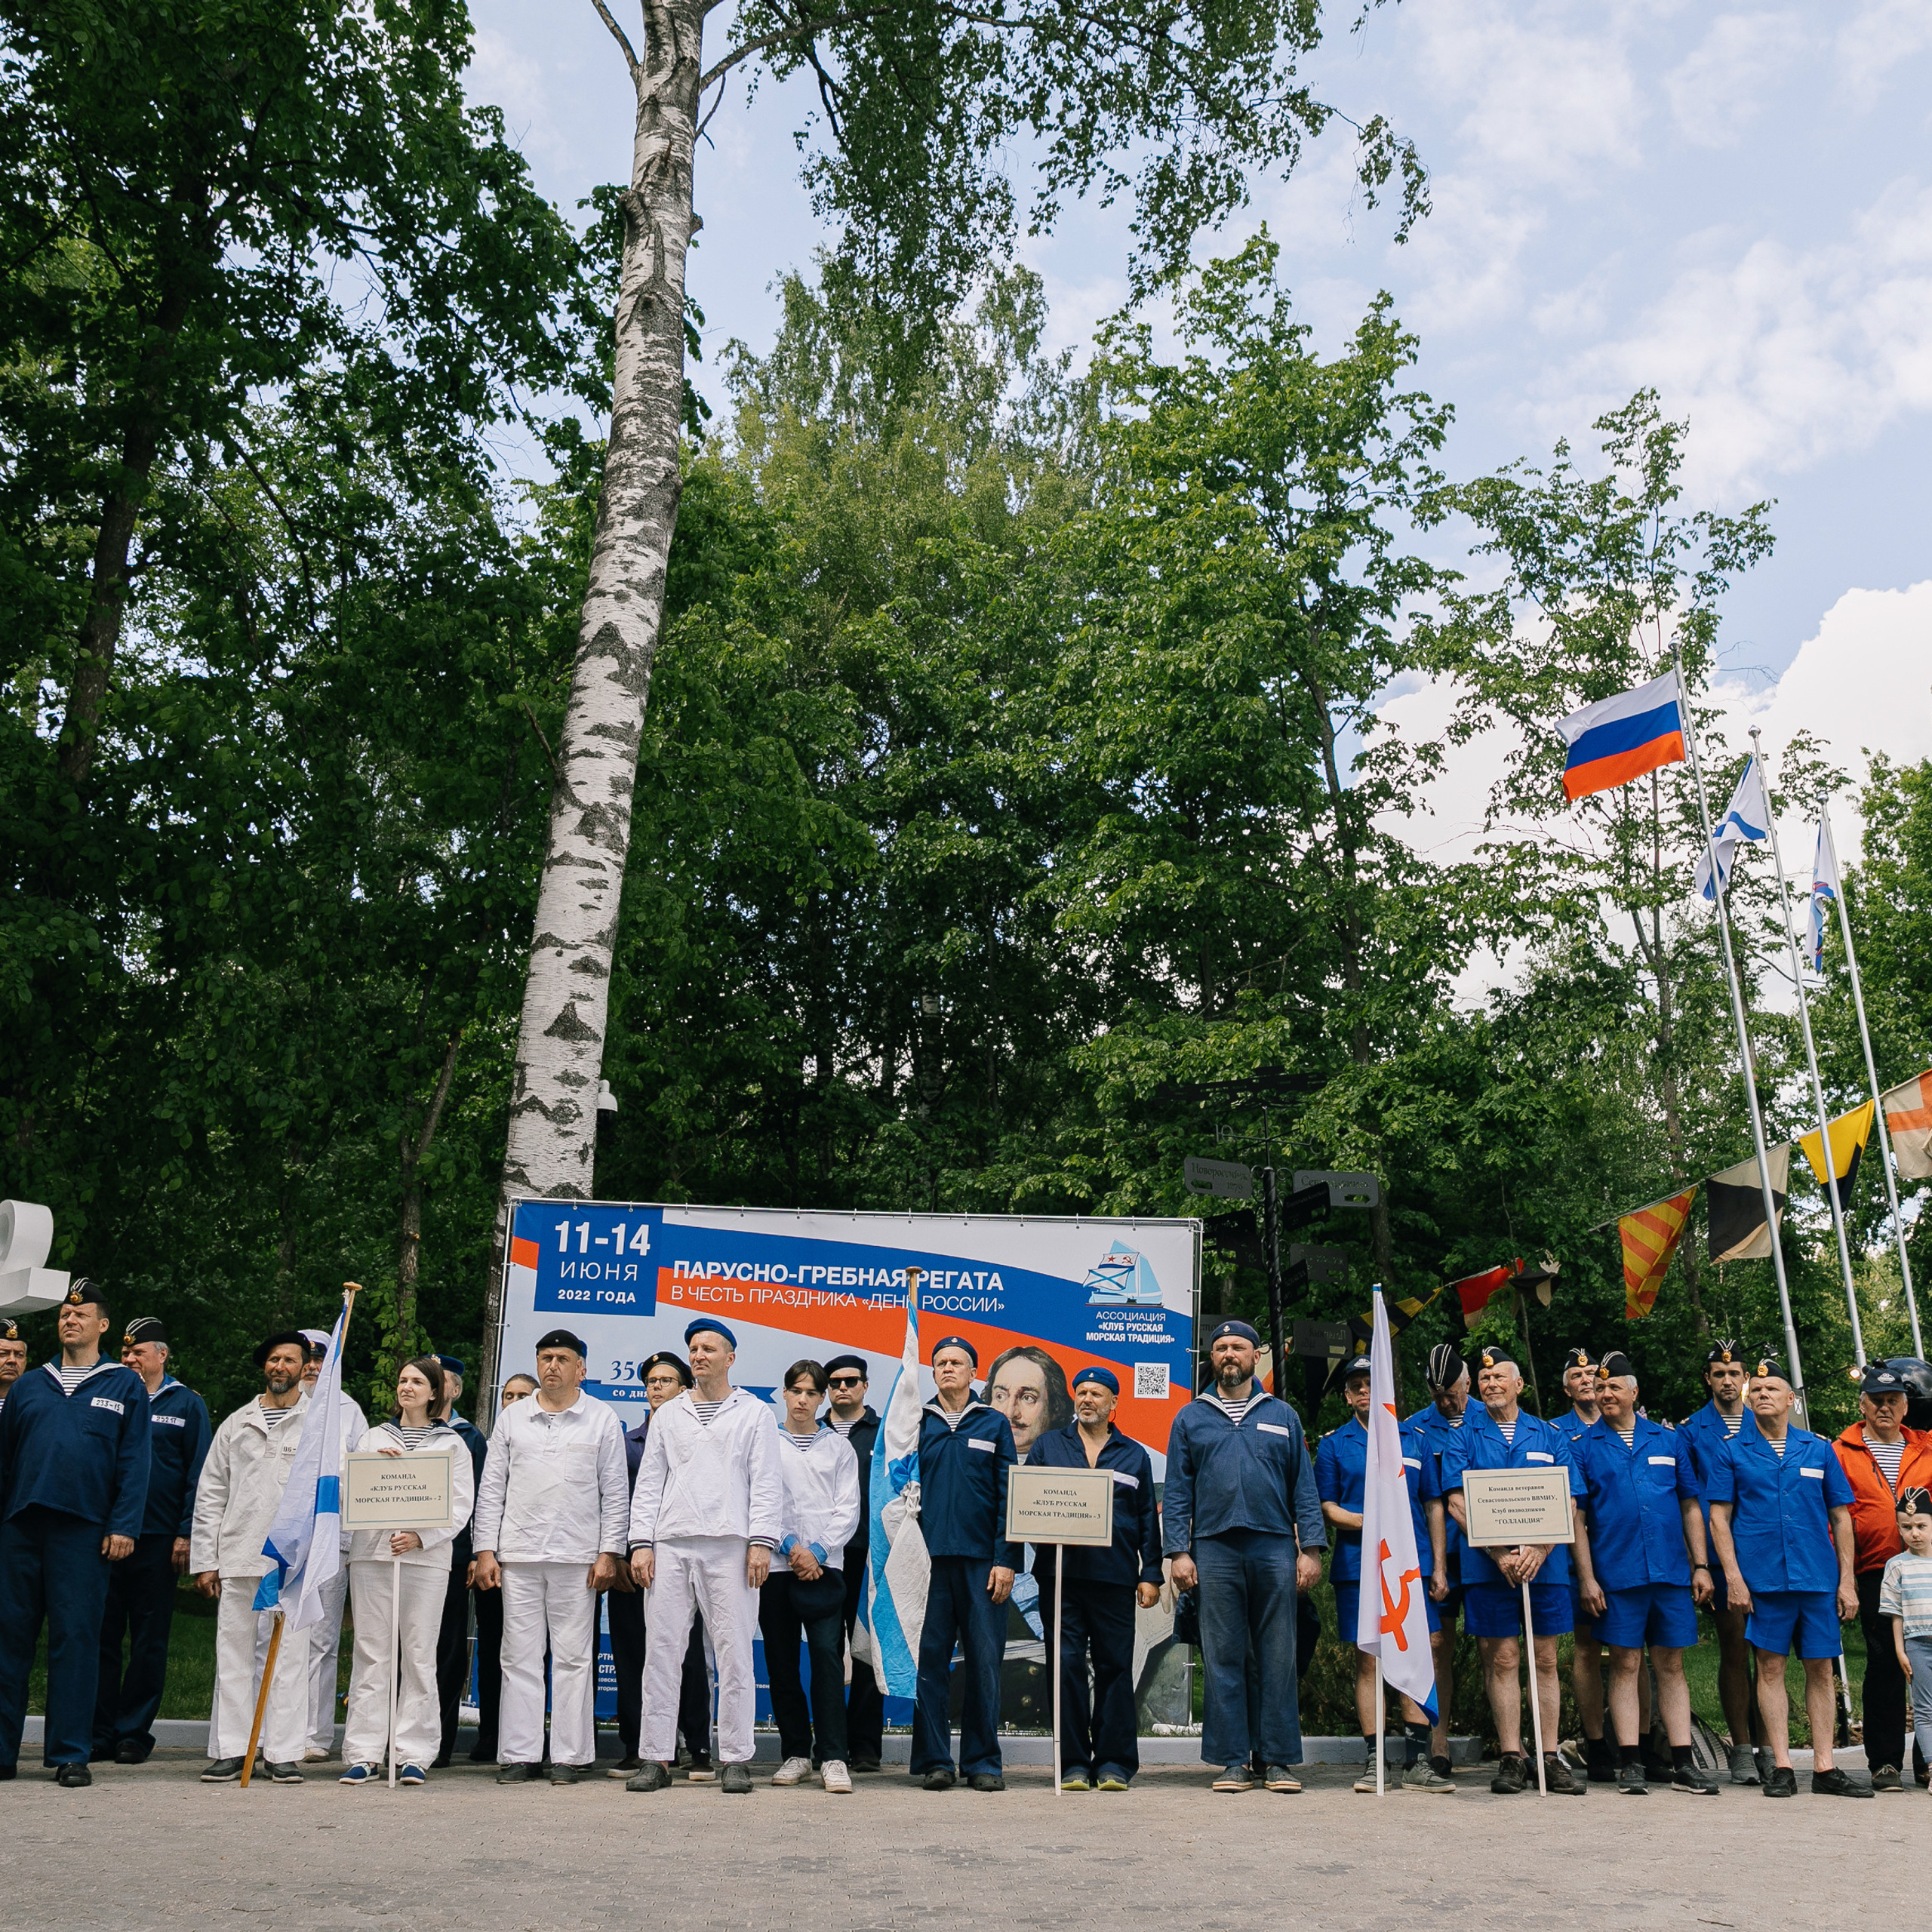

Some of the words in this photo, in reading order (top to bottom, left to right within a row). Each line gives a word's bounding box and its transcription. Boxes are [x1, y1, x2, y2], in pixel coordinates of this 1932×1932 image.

[555, 1220, 651, 1256] 11-14
[560, 1261, 638, 1281] ИЮНЯ
[673, 1260, 907, 1287] ПАРУСНО-ГРЕБНАЯ
[915, 1269, 1004, 1291] РЕГАТА
[558, 1289, 591, 1300] 2022
[596, 1291, 636, 1304] ГОДА
[671, 1285, 684, 1300] В
[688, 1286, 745, 1303] ЧЕСТЬ
[749, 1288, 857, 1308] ПРАЗДНИКА
[922, 1295, 1004, 1312] РОССИИ»
[1096, 1311, 1166, 1322] АССОЦИАЦИЯ
[1098, 1321, 1124, 1331] «КЛУБ
[1126, 1323, 1164, 1333] РУССКАЯ
[1086, 1332, 1126, 1342] МОРСКАЯ
[1128, 1334, 1175, 1344] ТРАДИЦИЯ»
[96, 1399, 121, 1411] 233-15
